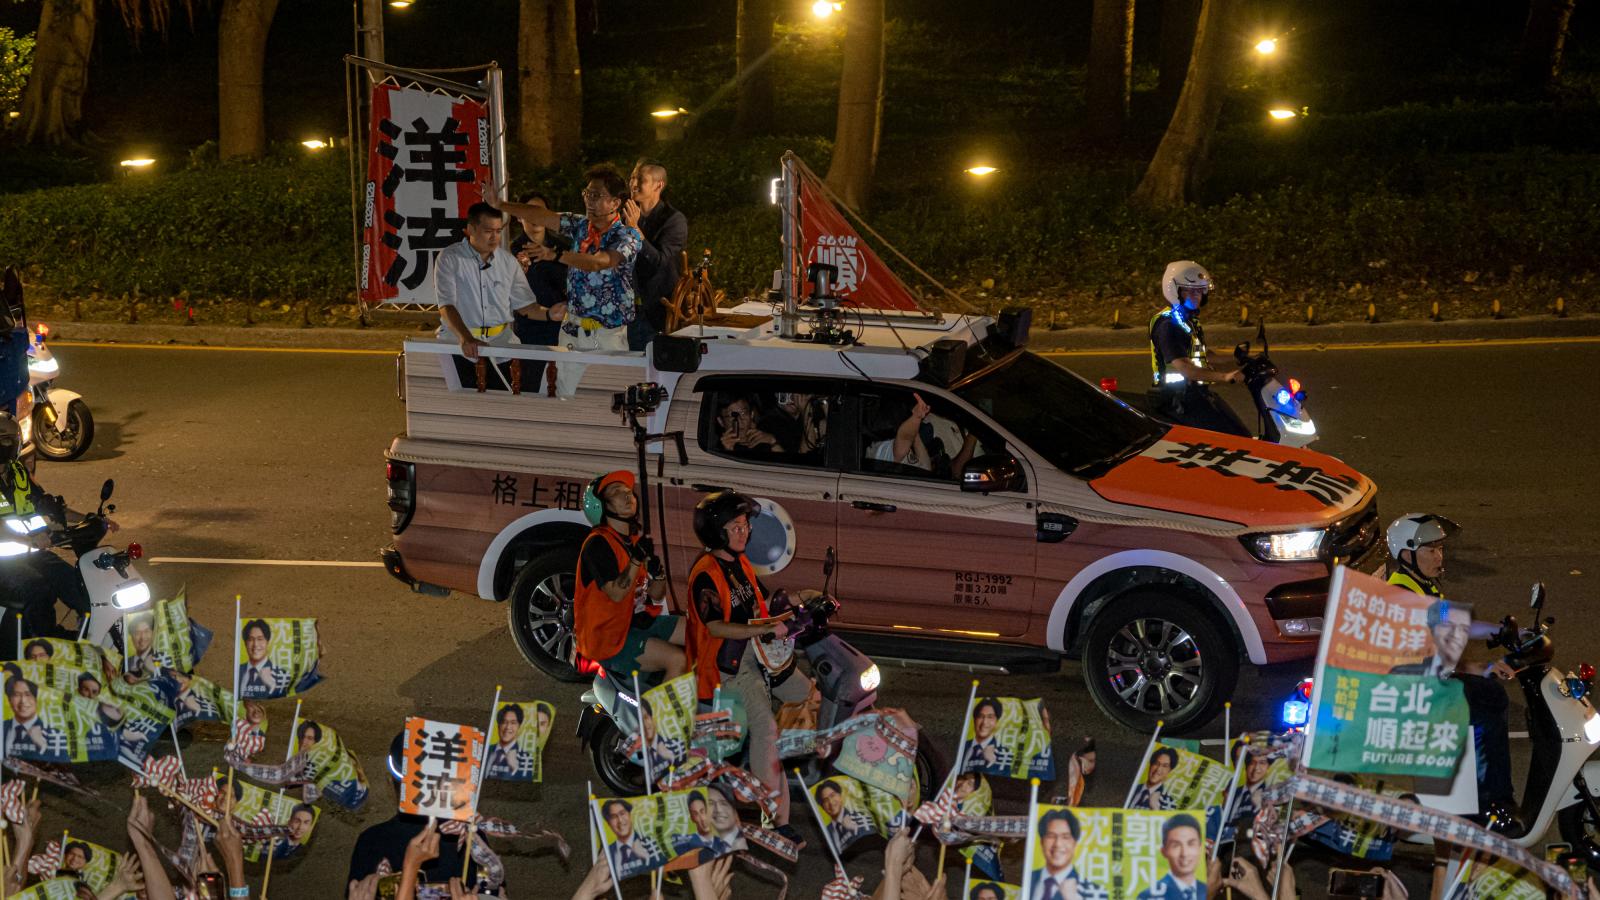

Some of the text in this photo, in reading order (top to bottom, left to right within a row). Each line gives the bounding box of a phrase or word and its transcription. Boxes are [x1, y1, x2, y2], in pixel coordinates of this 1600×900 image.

[817, 235, 858, 246] SOON
[491, 473, 582, 511] 格上租
[955, 572, 1013, 585] RGJ-1992
[1340, 608, 1427, 651] 沈伯洋
[1369, 681, 1434, 715] 台北
[1364, 717, 1460, 752] 順起來
[1362, 751, 1458, 767] FUTURE SOON
